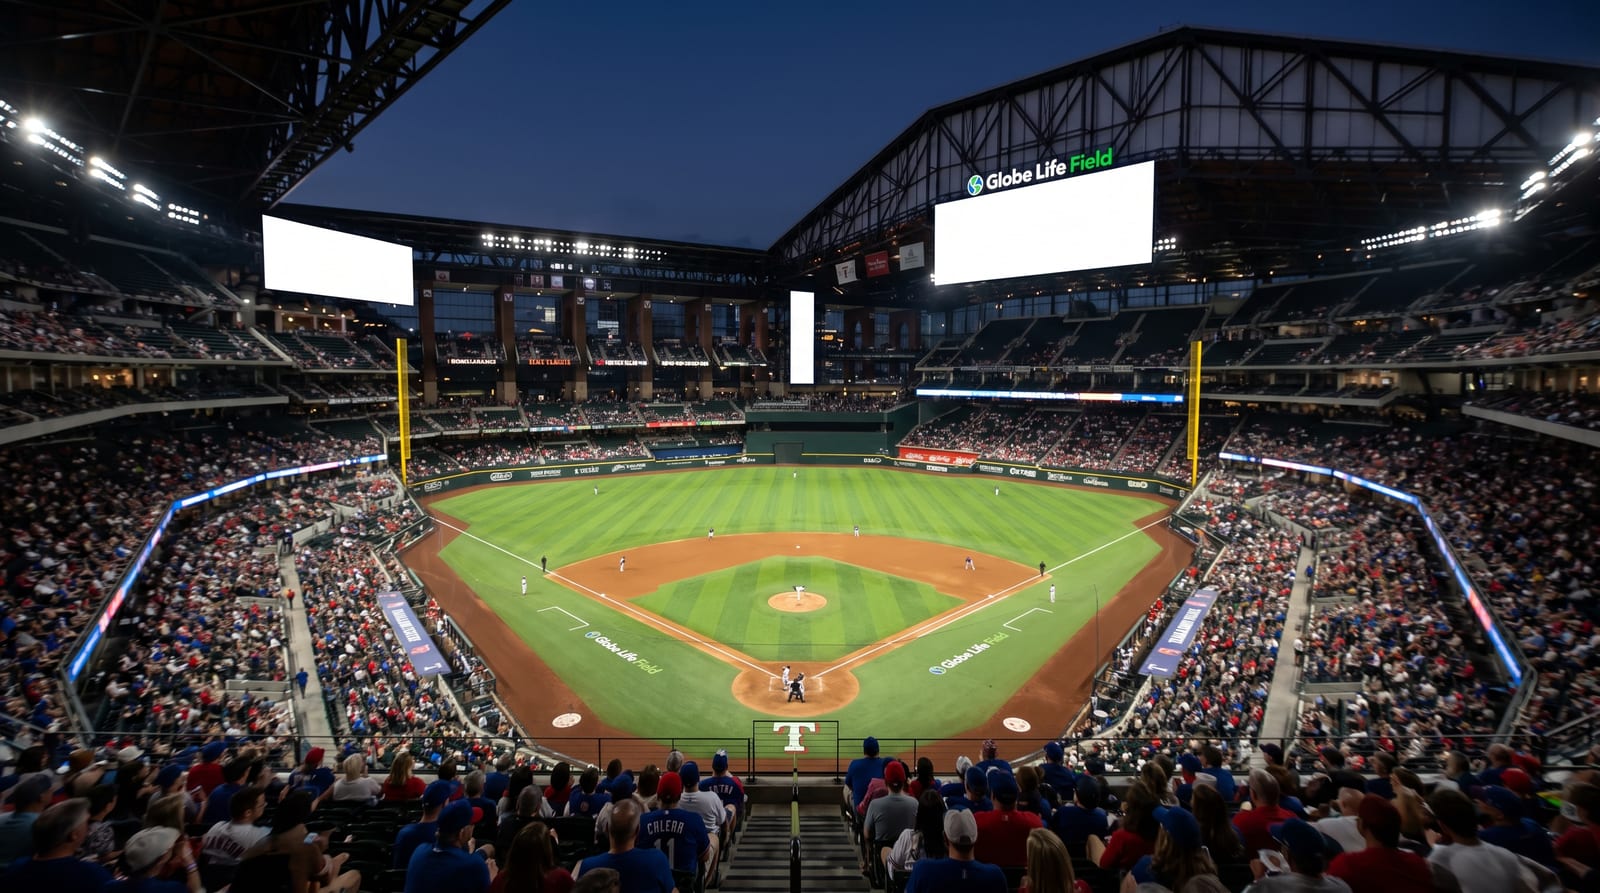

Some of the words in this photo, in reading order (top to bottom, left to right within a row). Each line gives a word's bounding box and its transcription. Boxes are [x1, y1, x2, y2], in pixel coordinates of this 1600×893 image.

[986, 168, 1032, 190] Globe
[1035, 159, 1067, 180] Life
[1069, 147, 1113, 173] Field
[595, 636, 620, 652] Globe
[616, 649, 637, 662] Life
[632, 658, 663, 674] Field
[941, 653, 974, 669] Globe
[966, 643, 990, 655] Life
[773, 722, 821, 754] T
